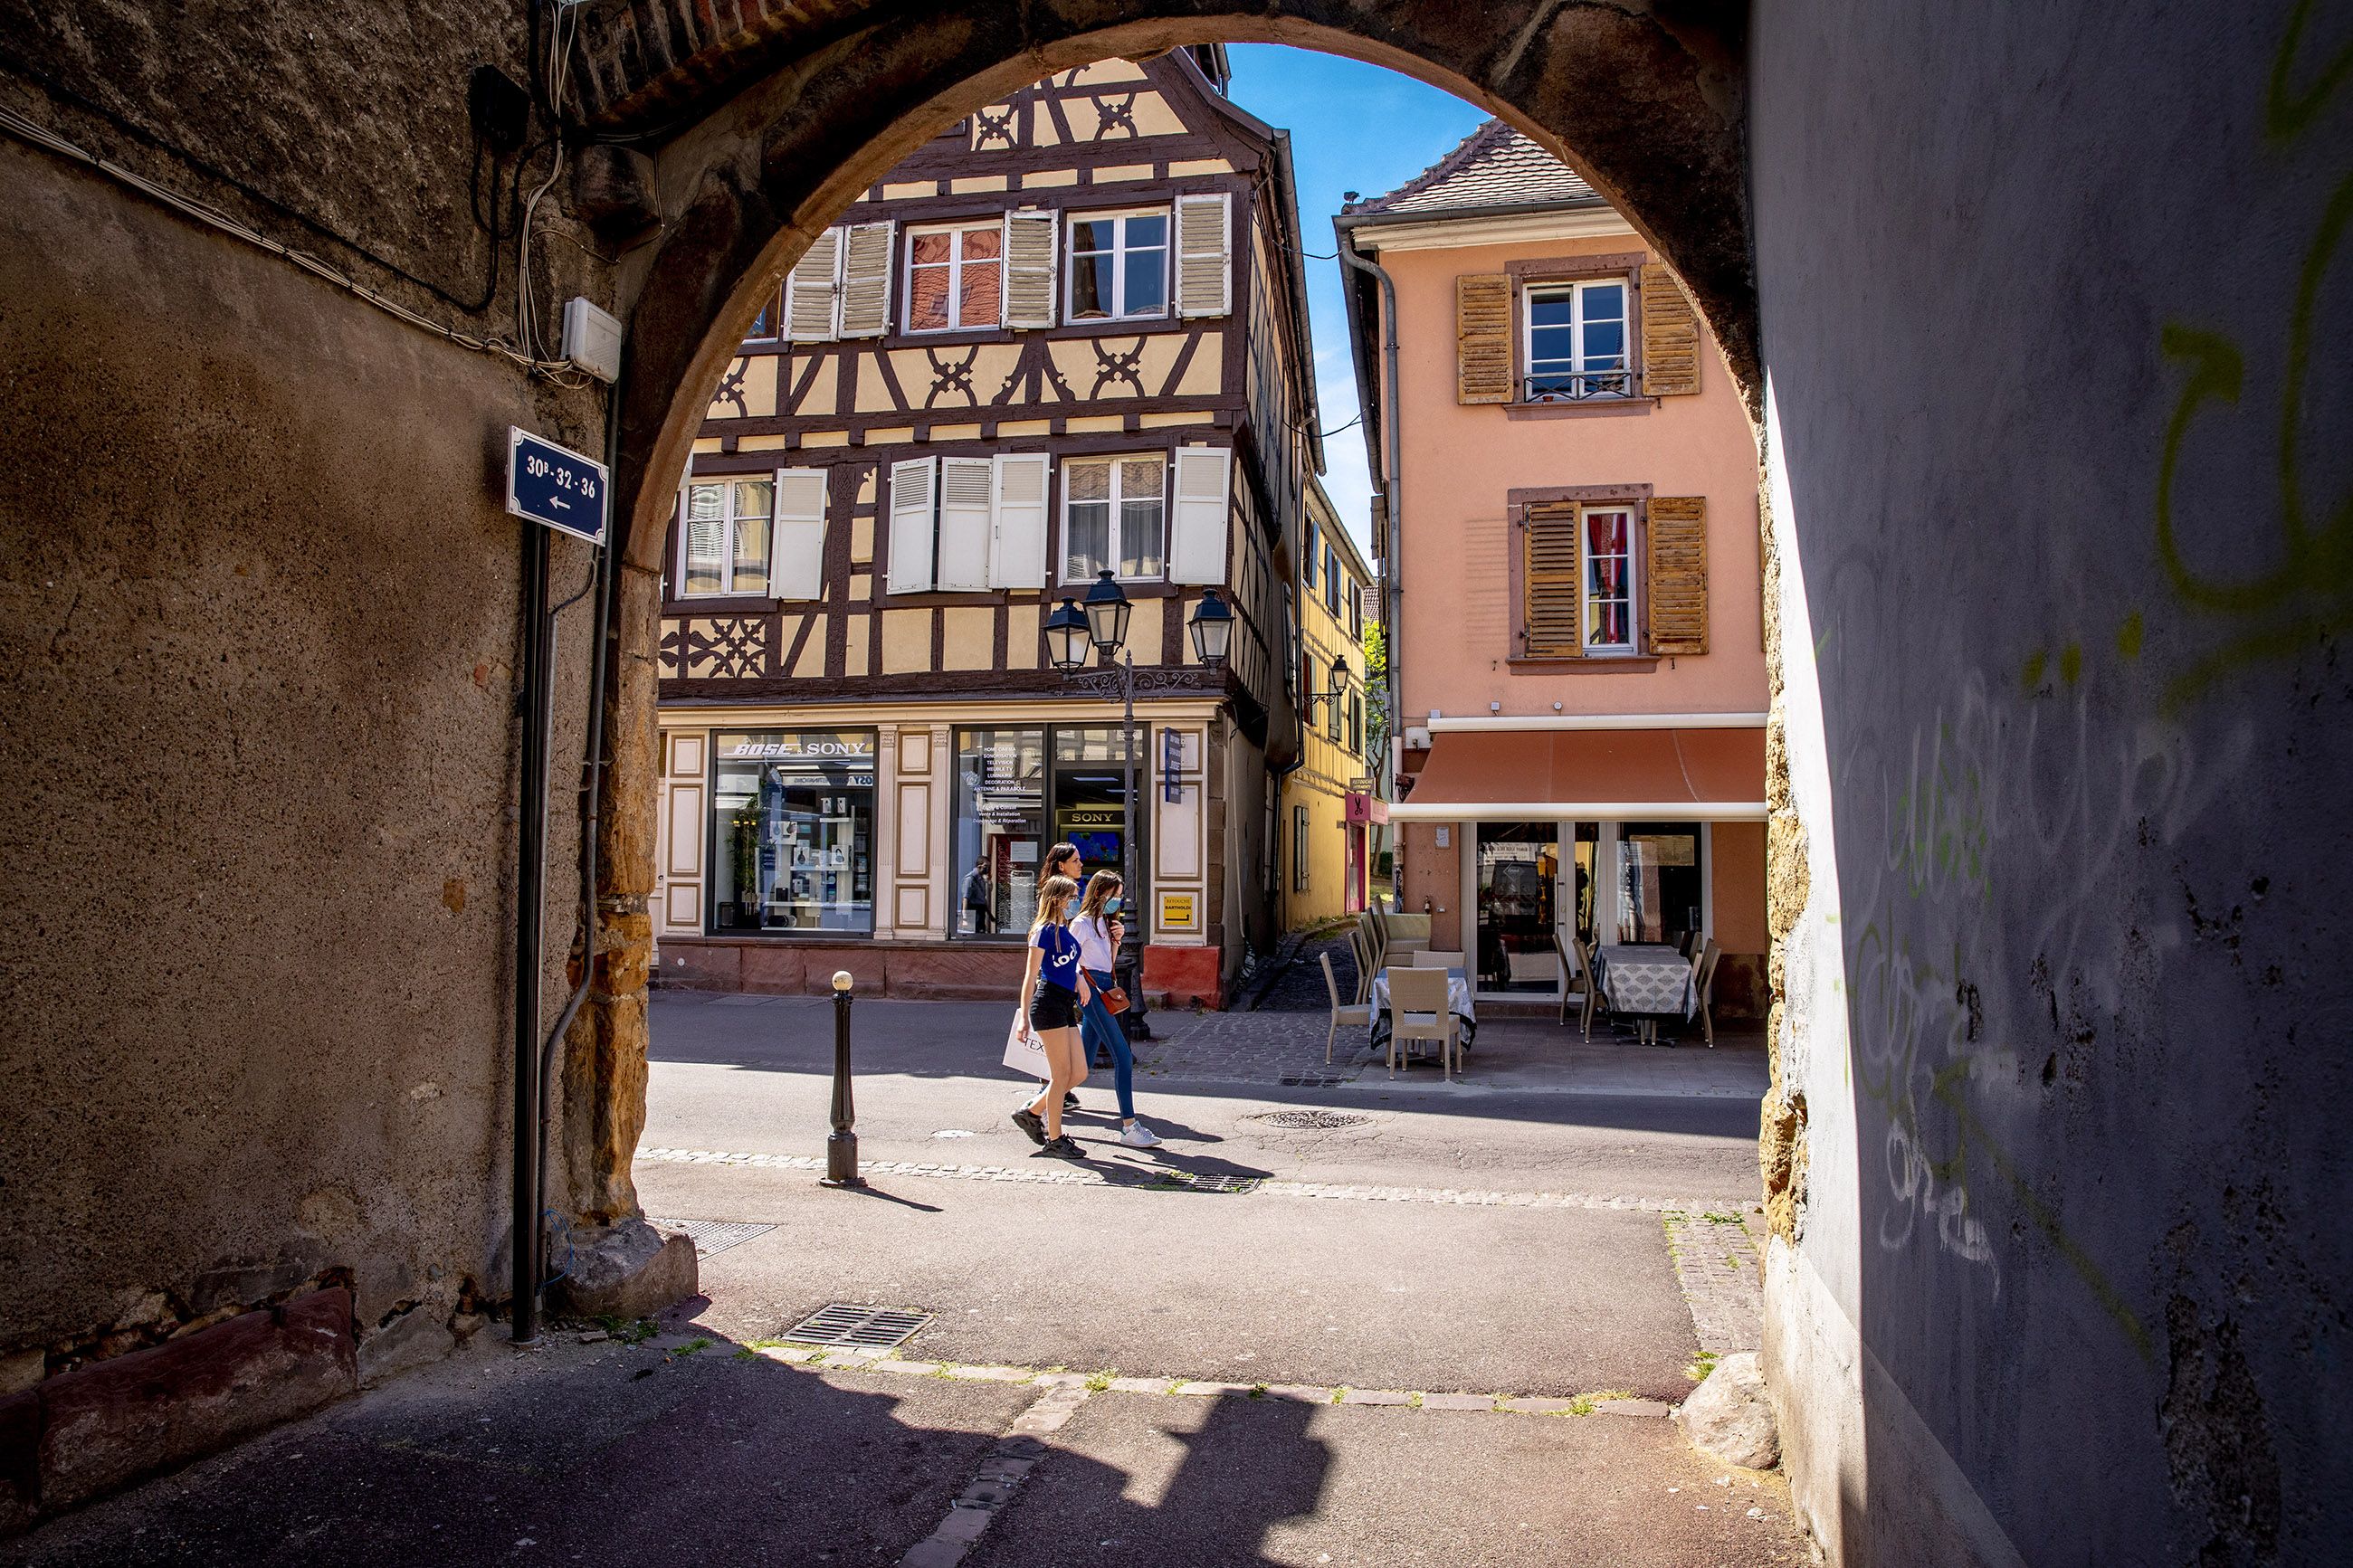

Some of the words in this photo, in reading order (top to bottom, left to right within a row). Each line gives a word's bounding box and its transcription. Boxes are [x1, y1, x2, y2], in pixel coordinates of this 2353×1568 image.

[724, 743, 802, 755] BOSE
[806, 743, 866, 755] SONY
[1072, 813, 1113, 822] SONY
